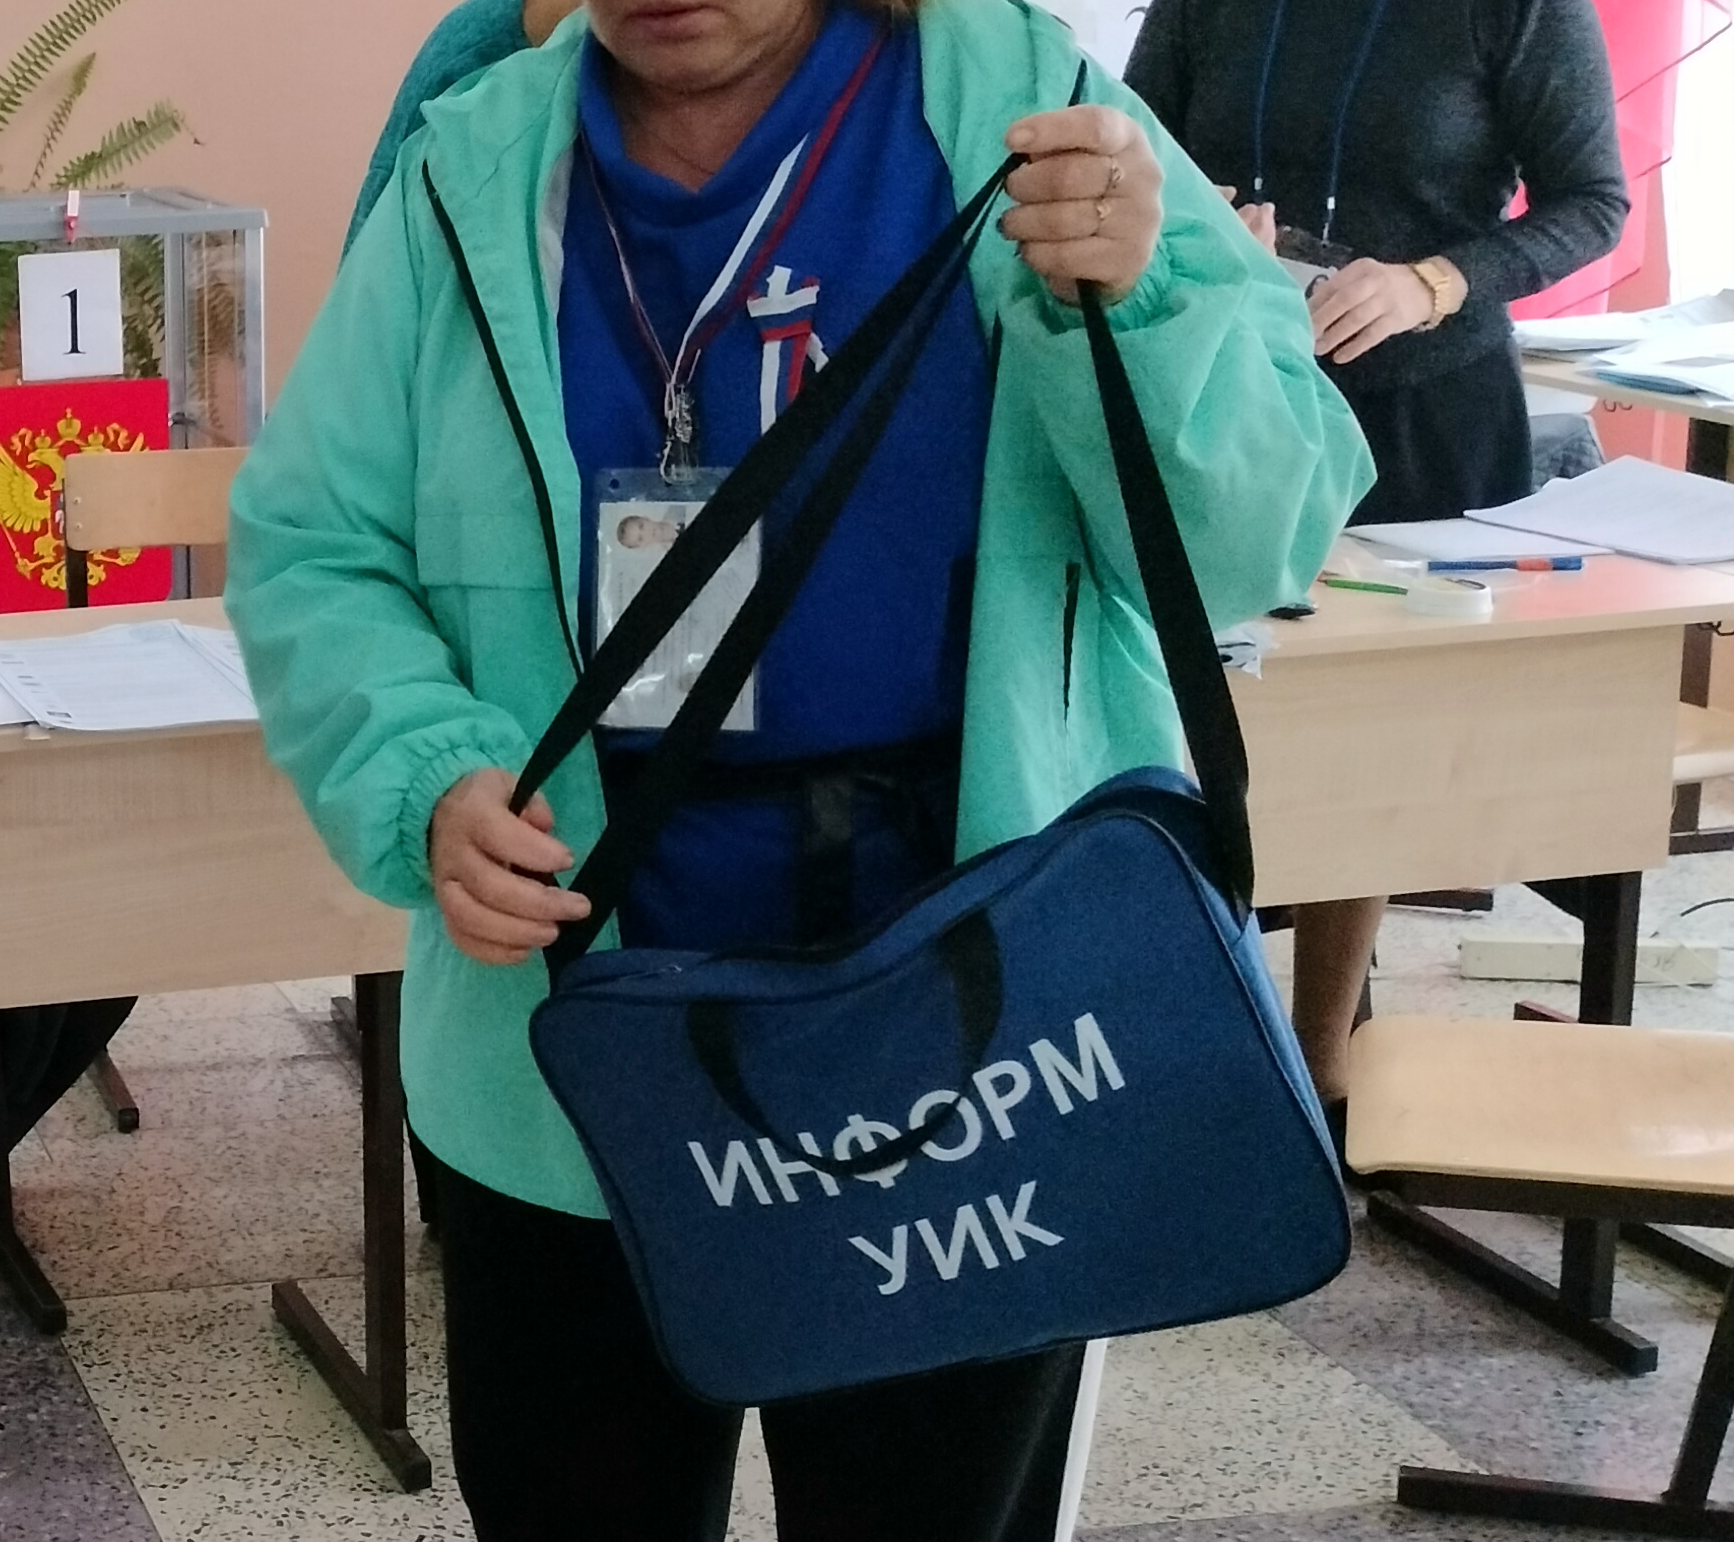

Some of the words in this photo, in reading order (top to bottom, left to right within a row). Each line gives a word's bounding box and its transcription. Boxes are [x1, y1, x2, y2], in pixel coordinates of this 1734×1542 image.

[60, 288, 87, 355] 1
[687, 1011, 1126, 1208] ИНФОРМ
[847, 1179, 1064, 1296] УИК
